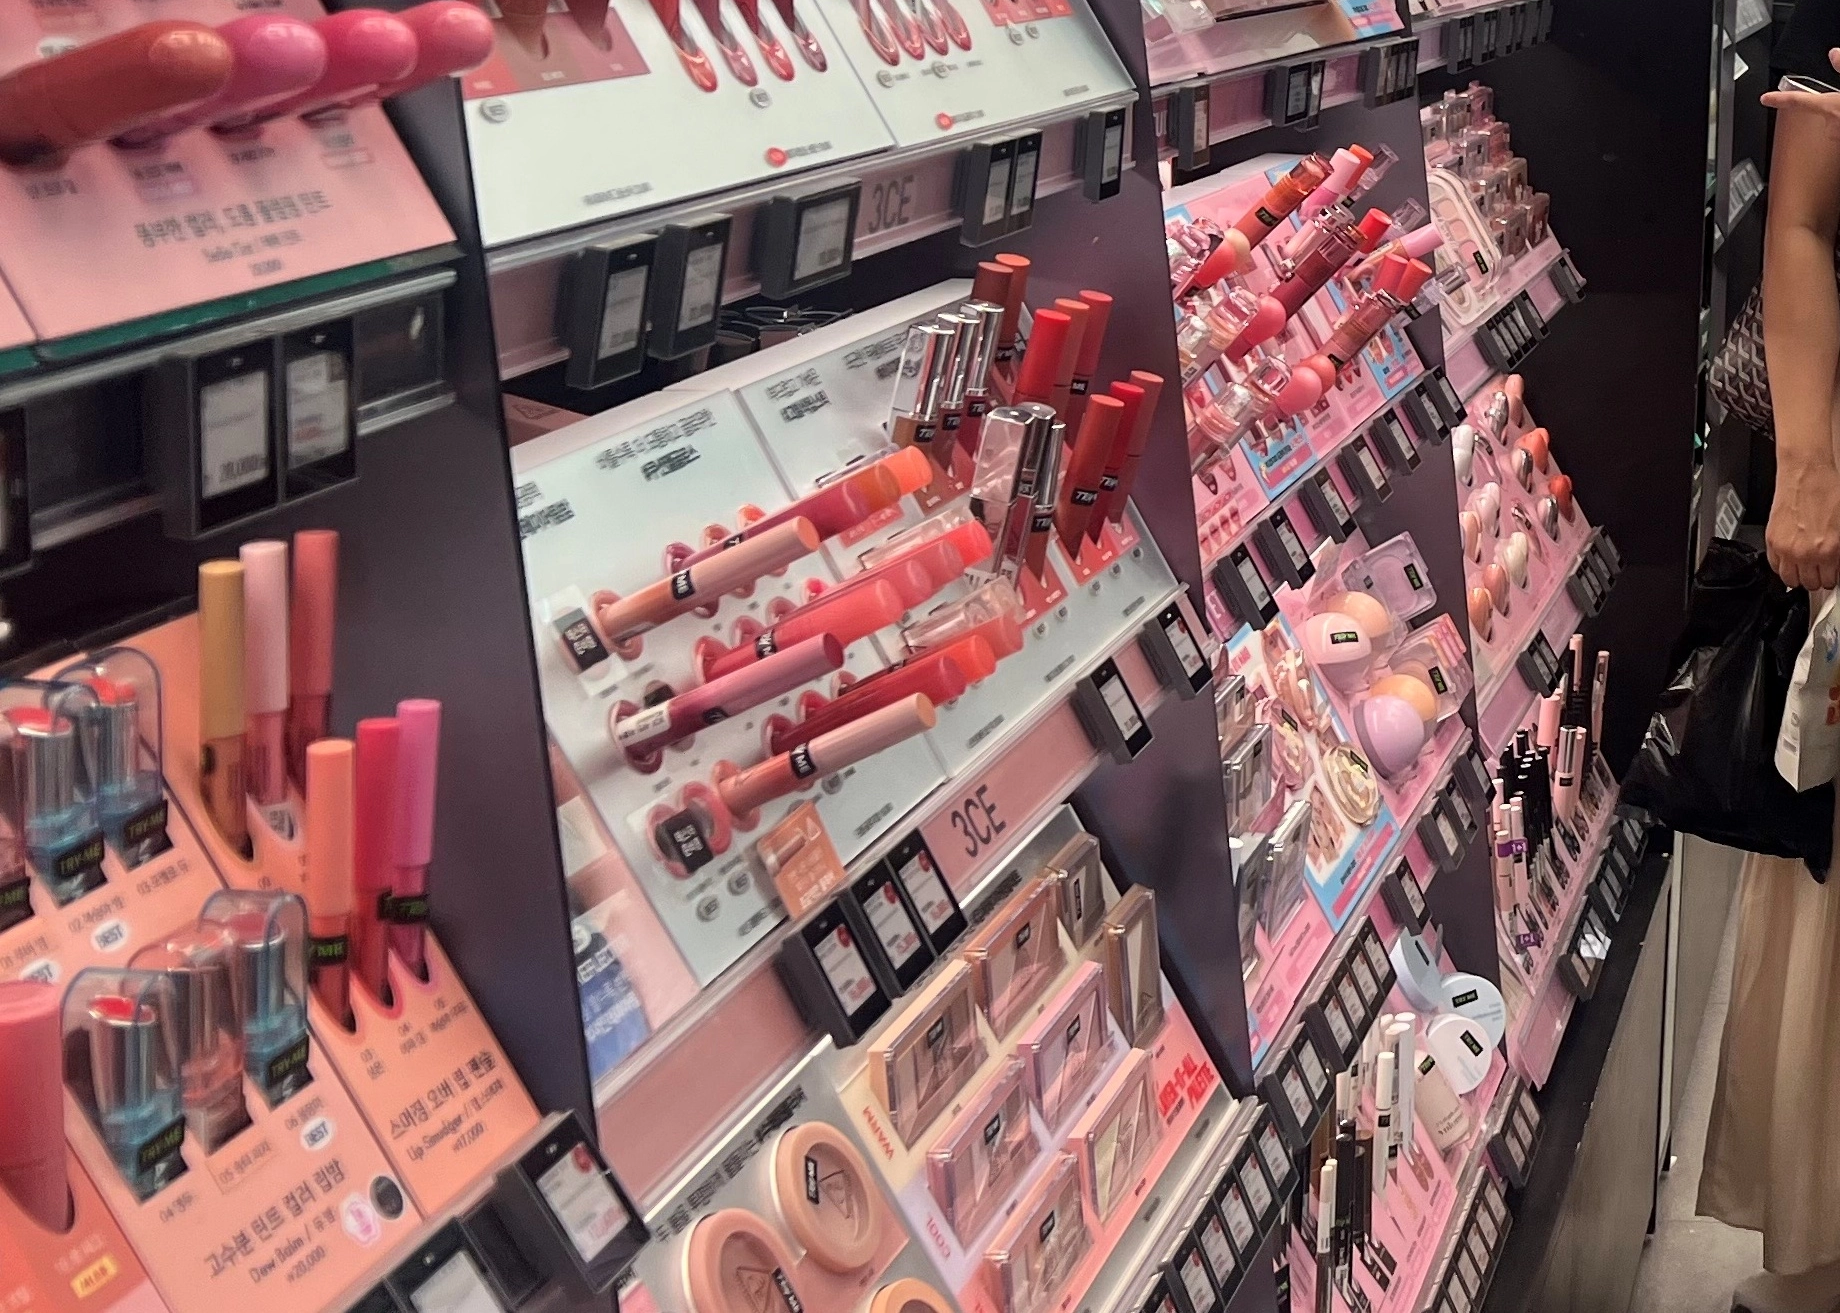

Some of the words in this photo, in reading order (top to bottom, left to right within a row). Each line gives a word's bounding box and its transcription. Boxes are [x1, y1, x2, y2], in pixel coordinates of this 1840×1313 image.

[867, 174, 915, 234] 3CE
[950, 783, 1007, 858] 3CE
[94, 923, 125, 949] BEST
[426, 1080, 455, 1112] 오버
[453, 1067, 472, 1091] 립
[302, 1120, 330, 1148] BEST
[251, 1205, 286, 1244] 틴트
[281, 1180, 317, 1218] 컬러
[311, 1158, 347, 1195] 립밤
